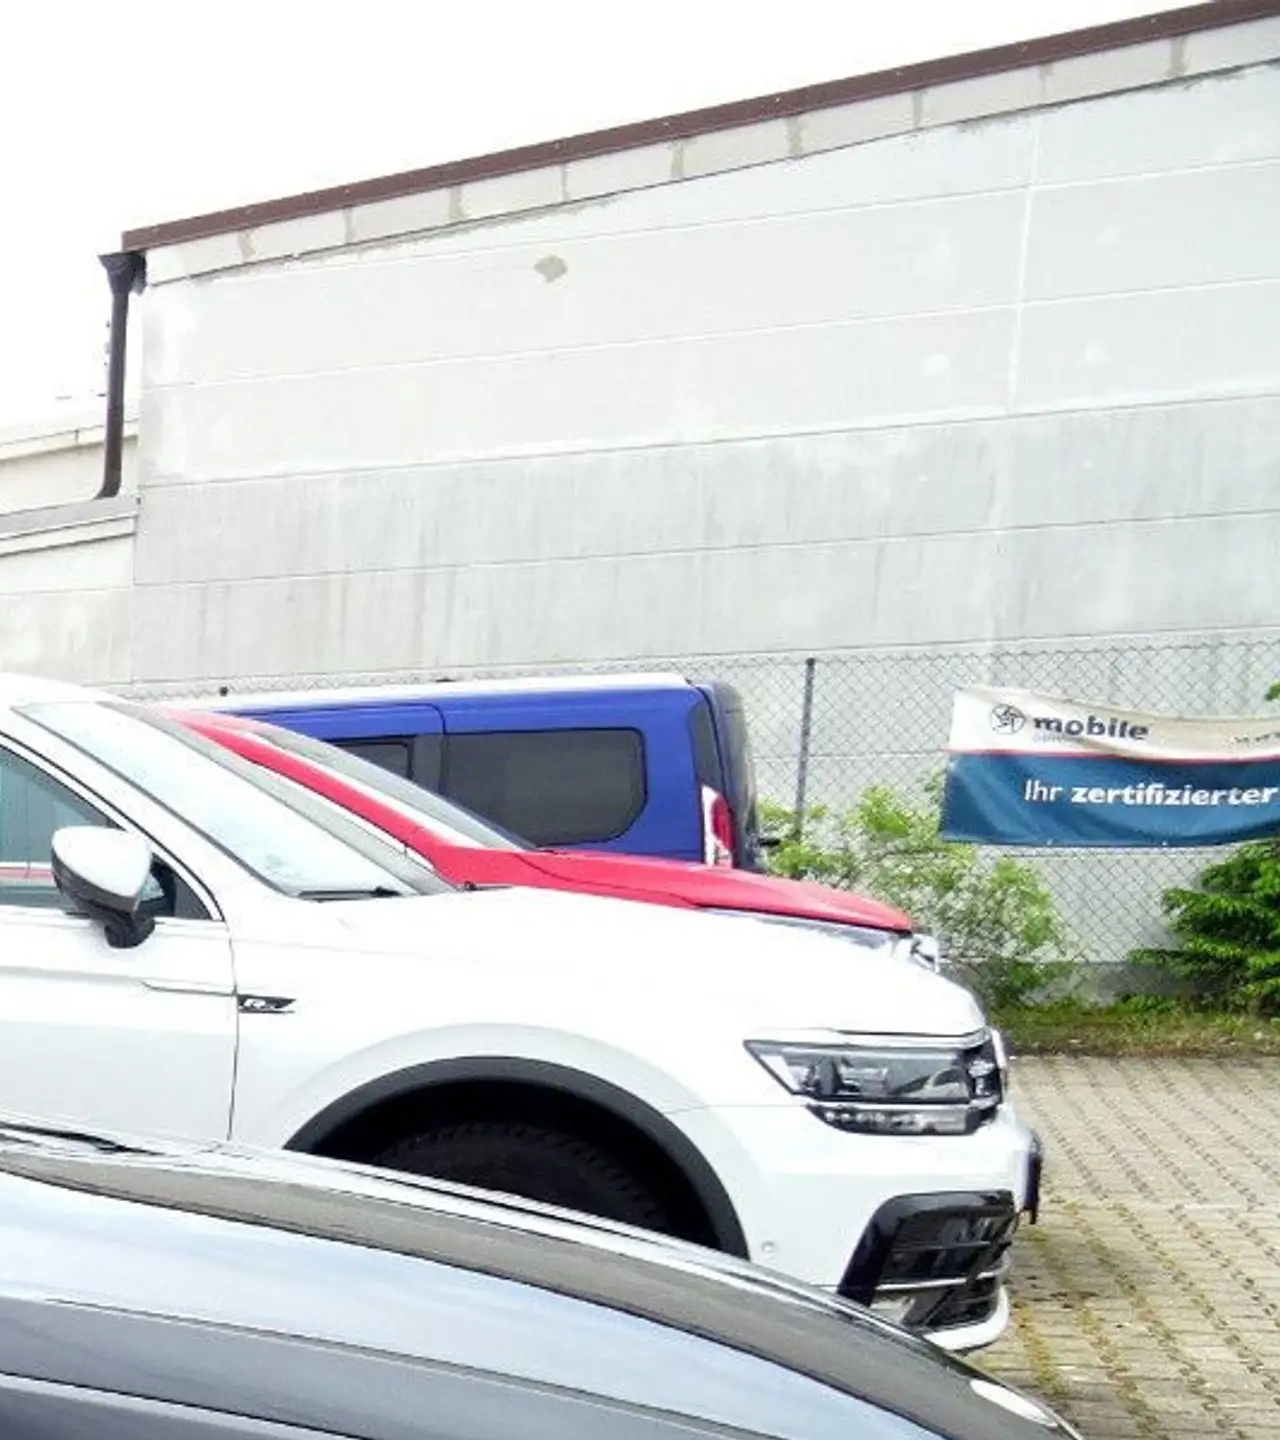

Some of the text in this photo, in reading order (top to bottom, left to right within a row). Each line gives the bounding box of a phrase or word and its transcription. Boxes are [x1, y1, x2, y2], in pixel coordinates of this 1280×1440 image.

[1033, 715, 1149, 740] mobile
[1024, 779, 1280, 806] Ihr zertifizierter
